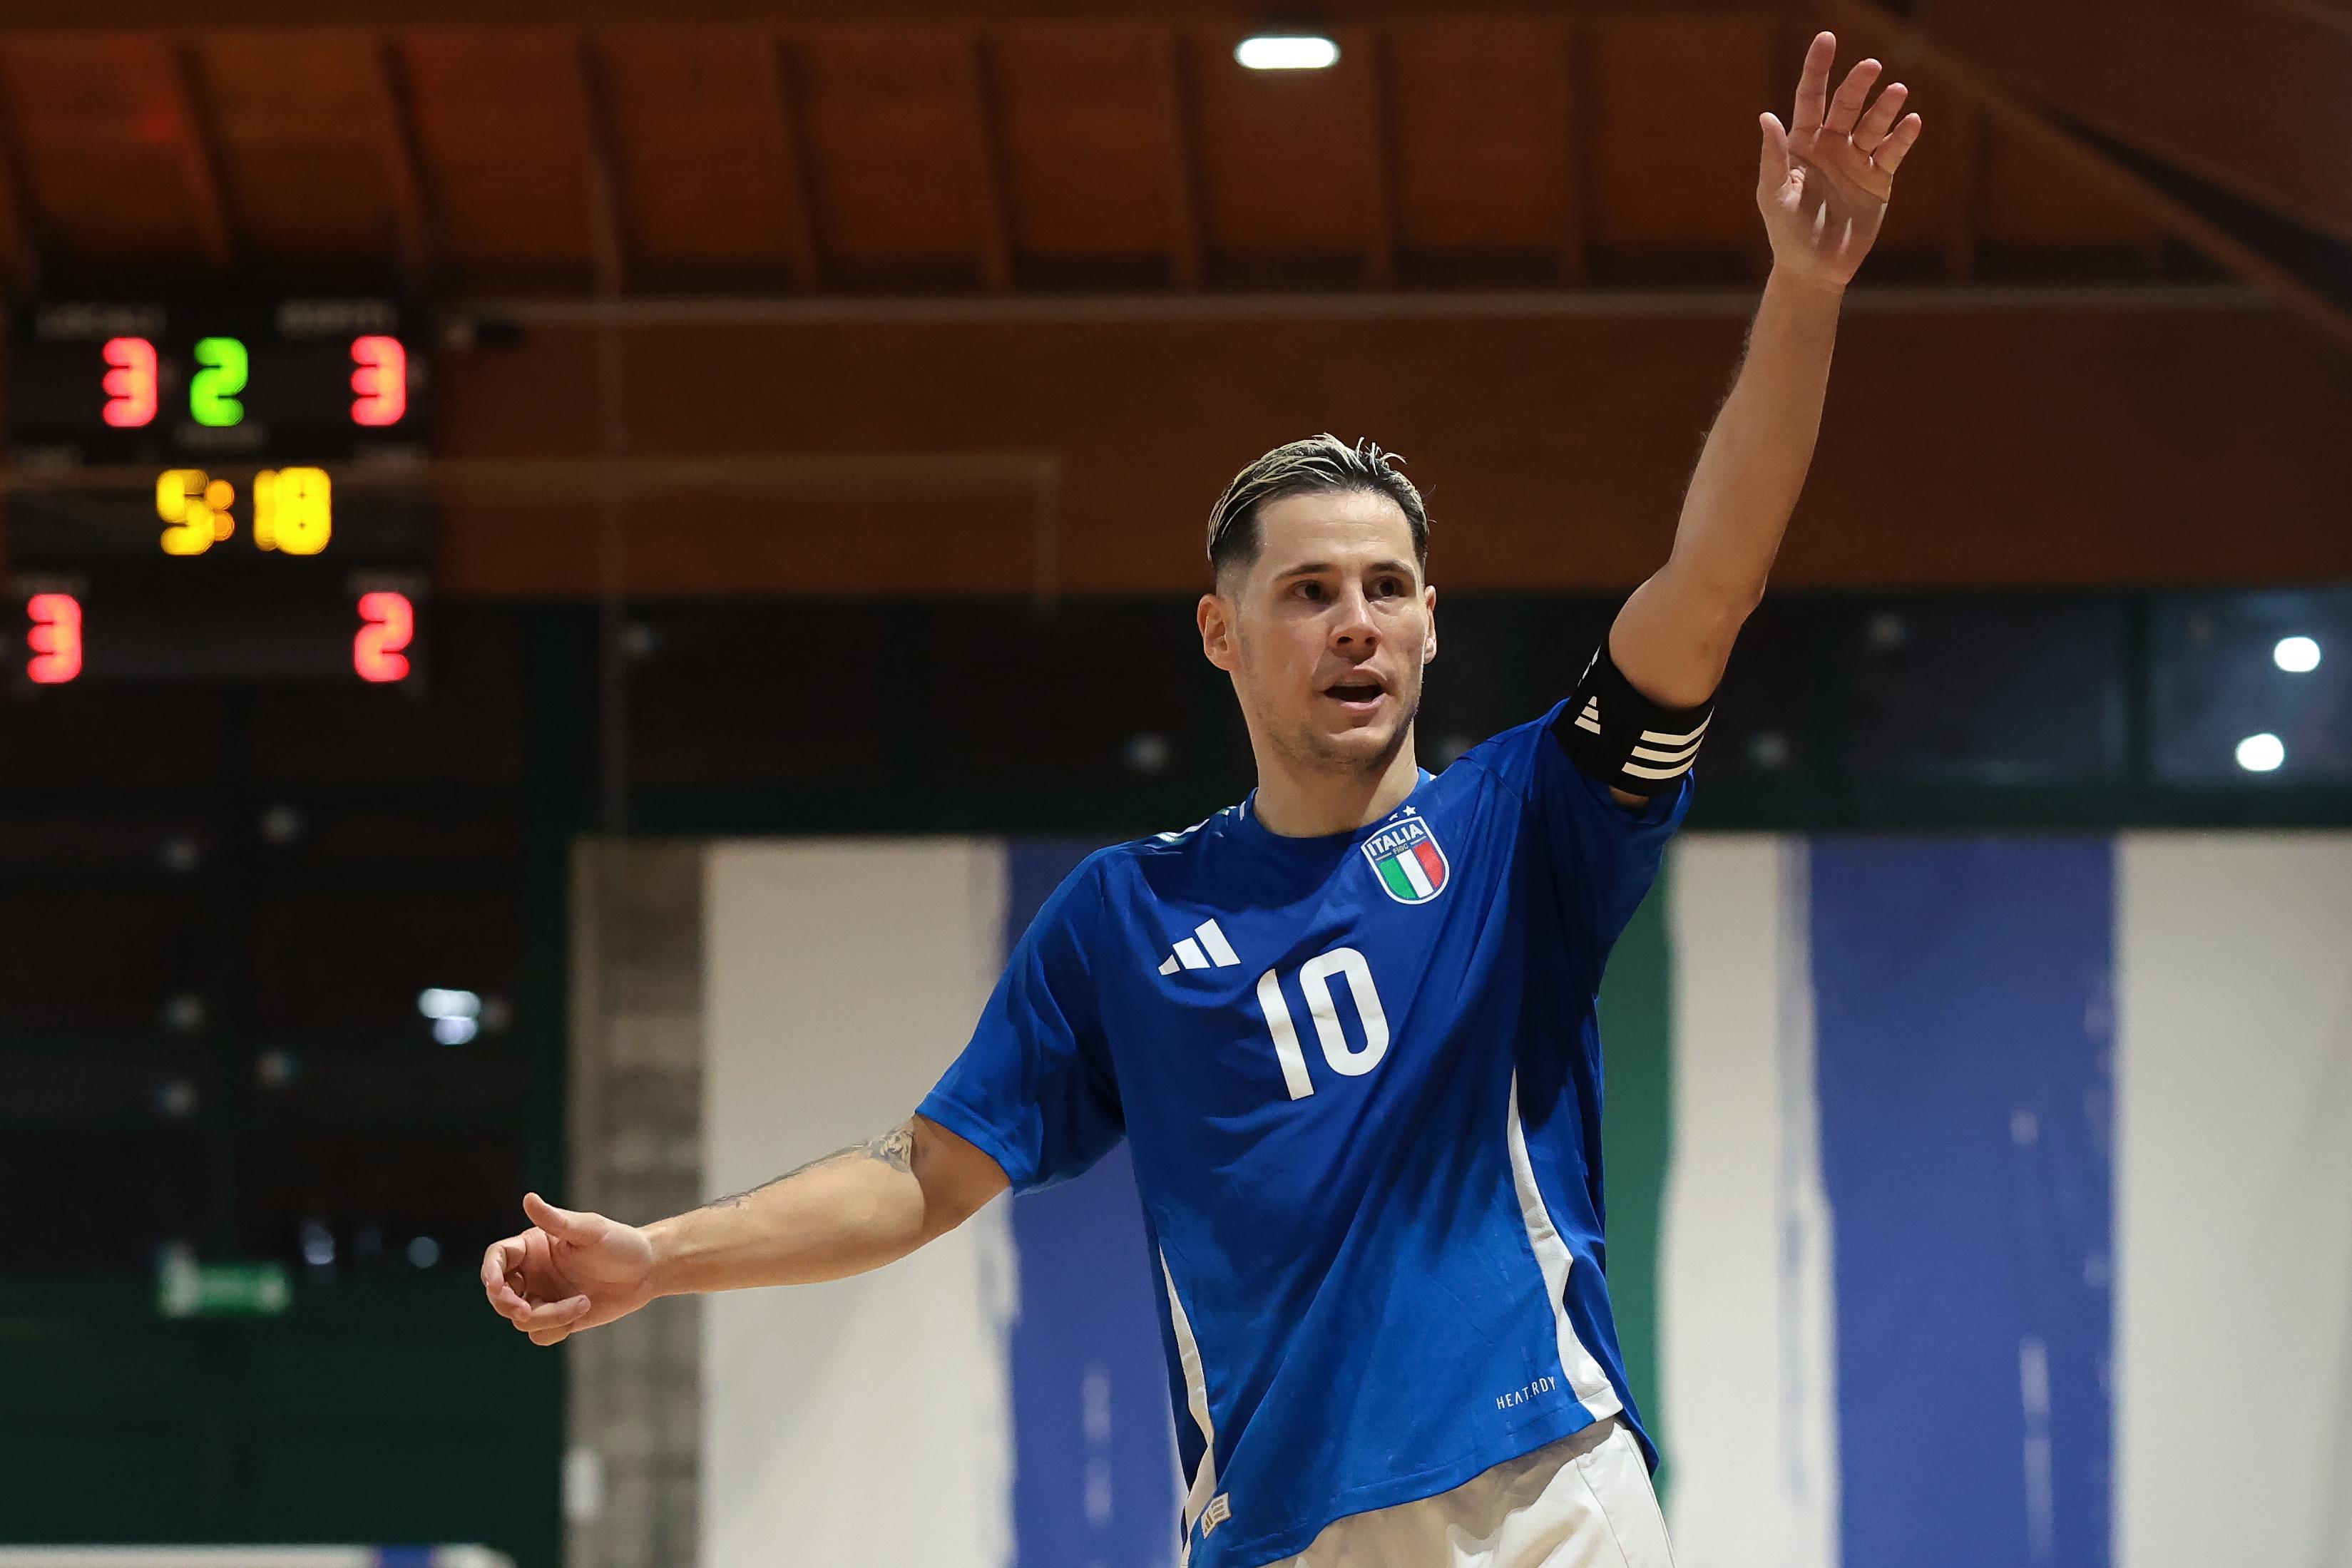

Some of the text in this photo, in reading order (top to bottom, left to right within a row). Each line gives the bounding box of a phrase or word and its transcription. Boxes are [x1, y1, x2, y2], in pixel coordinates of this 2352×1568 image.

[102, 337, 158, 428] 3
[190, 337, 248, 427] 2
[350, 335, 407, 426] 3
[26, 593, 83, 684] 3
[354, 591, 414, 682] 2
[1366, 824, 1424, 856] ITALIA
[1257, 947, 1389, 1101] 10
[1495, 1375, 1555, 1410] HEAT.RDY
